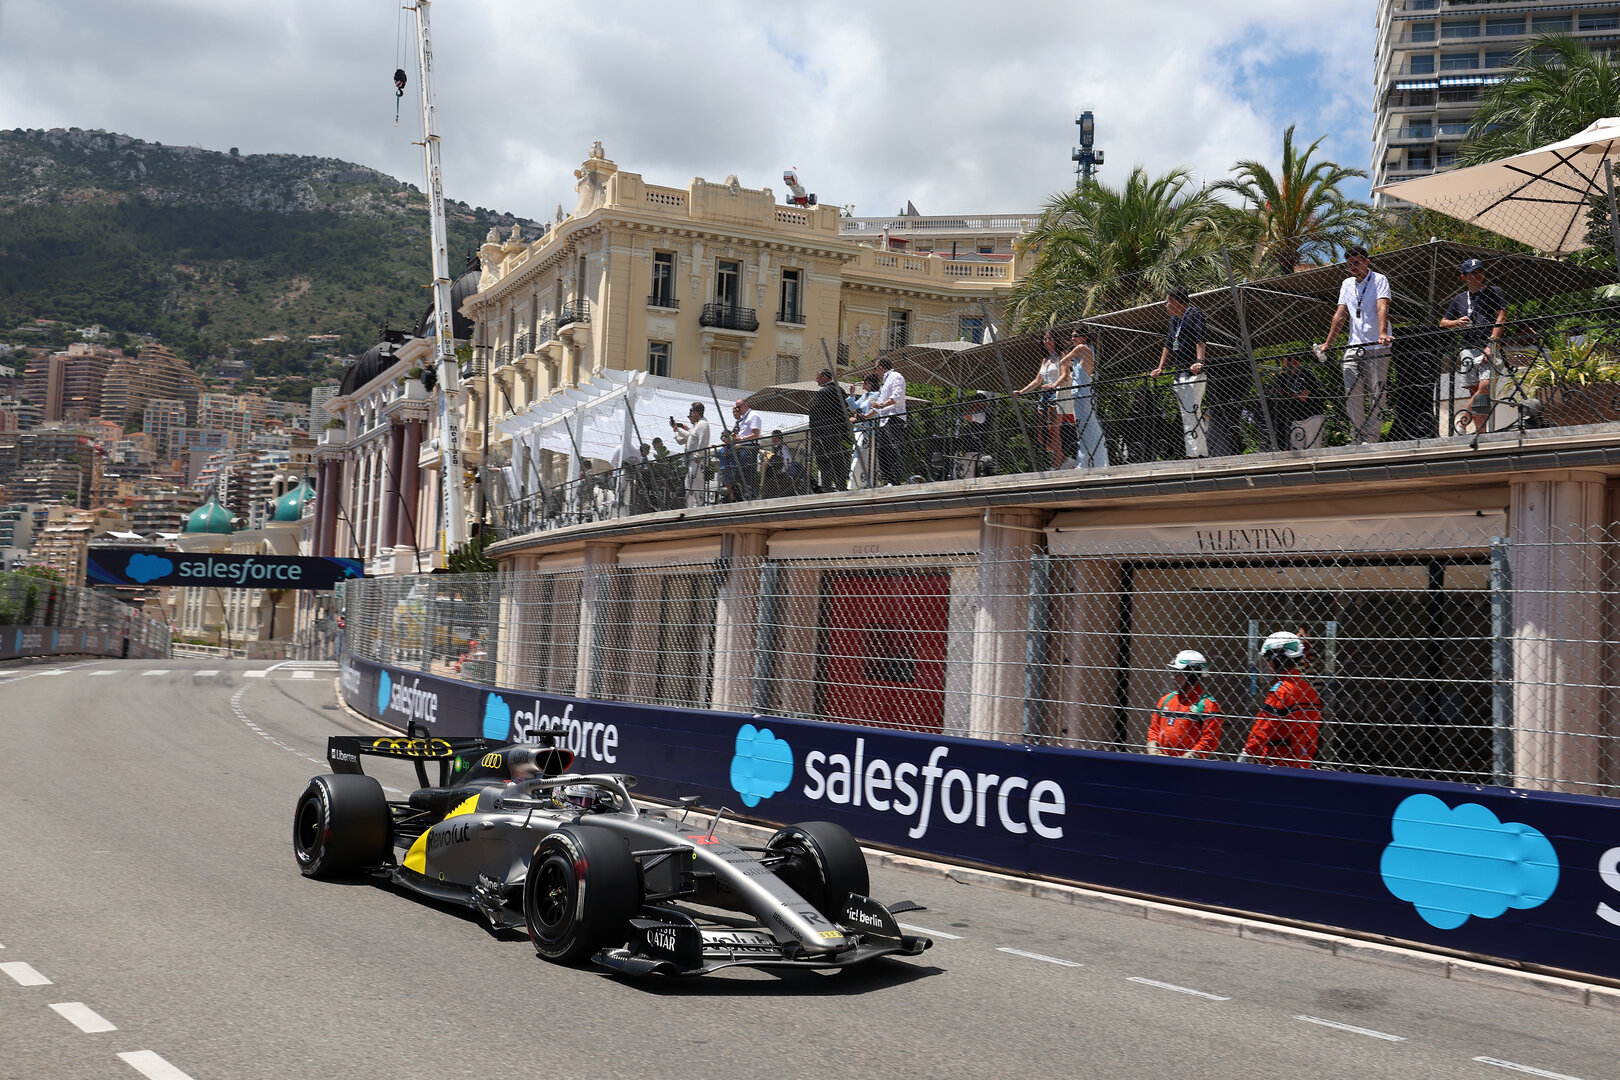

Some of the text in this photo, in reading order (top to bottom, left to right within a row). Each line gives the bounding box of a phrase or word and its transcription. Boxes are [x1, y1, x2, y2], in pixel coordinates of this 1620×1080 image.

[449, 425, 459, 465] Mediaco
[1195, 527, 1296, 550] VALENTINO
[178, 557, 302, 585] salesforce
[390, 675, 438, 726] salesforce
[803, 738, 1066, 839] salesforce
[427, 822, 471, 852] Revolut
[859, 910, 883, 928] berlin
[646, 930, 676, 951] QATAR
